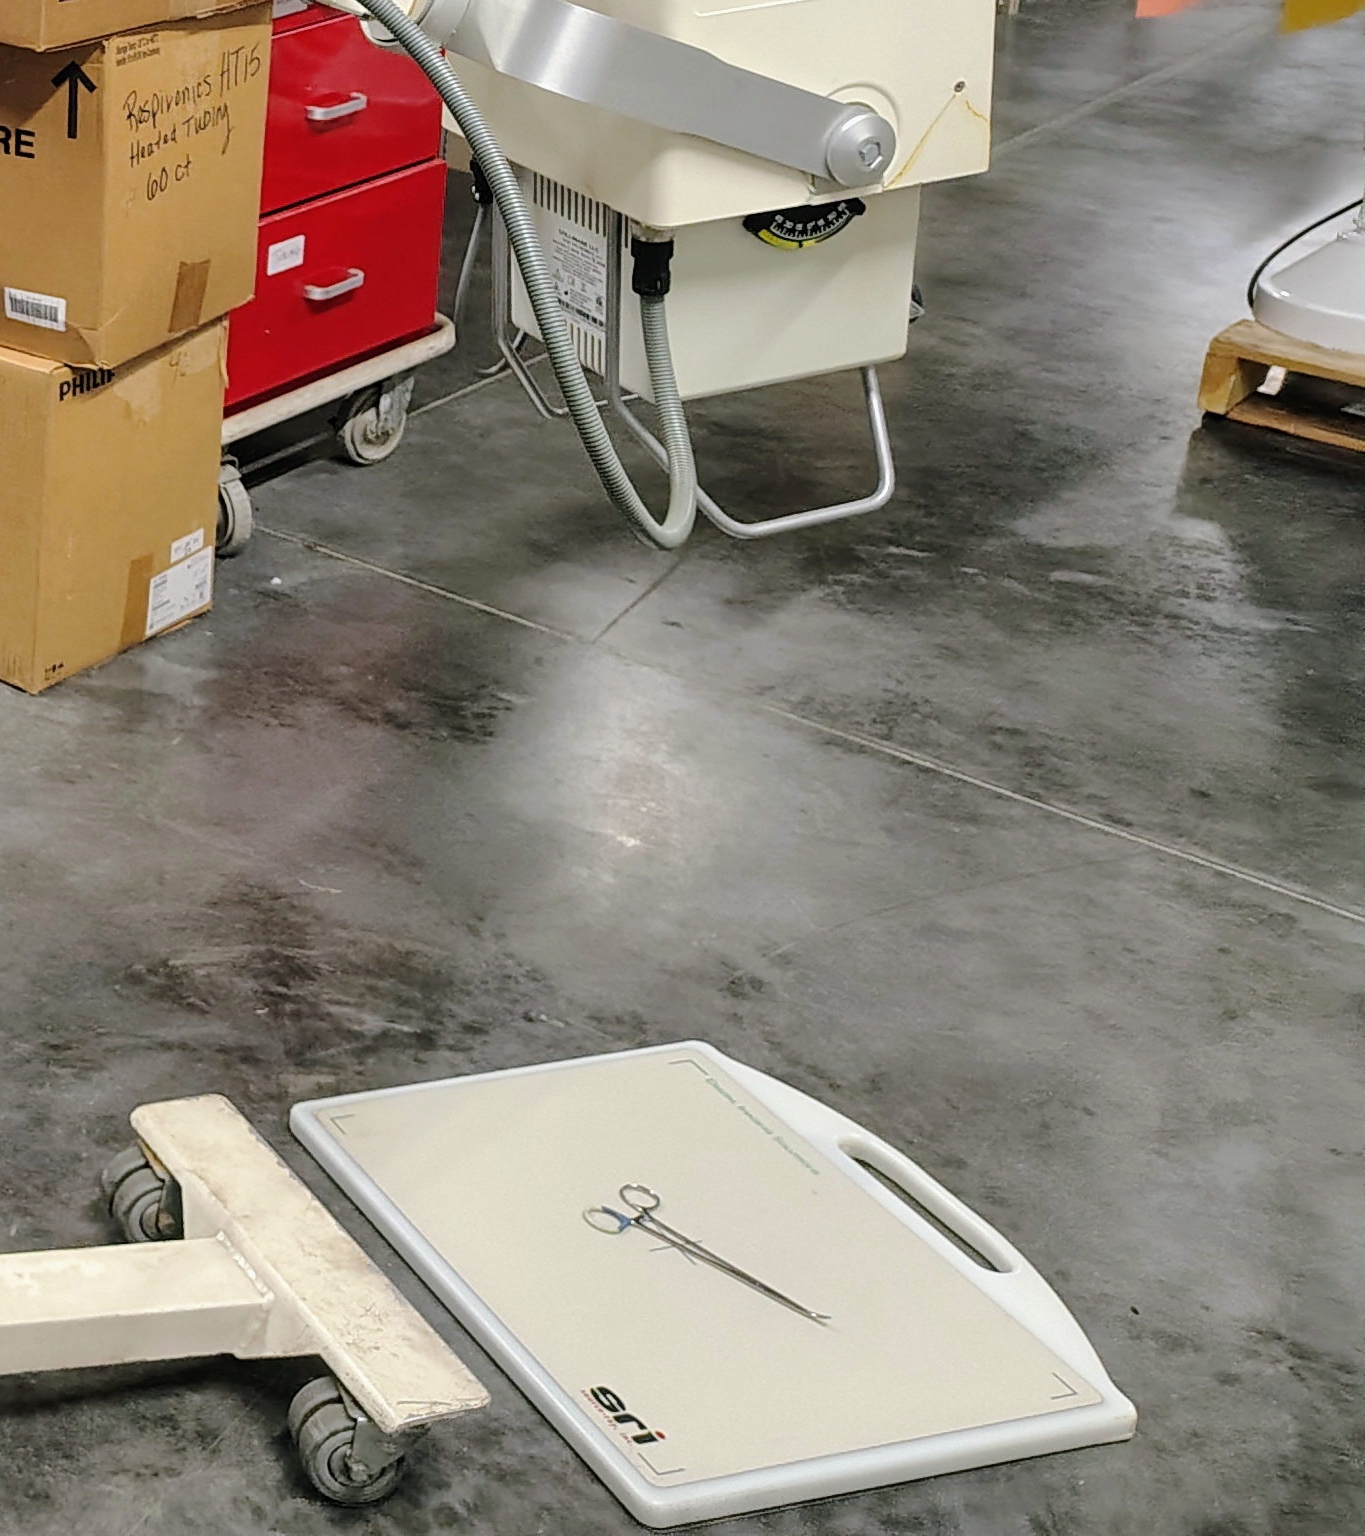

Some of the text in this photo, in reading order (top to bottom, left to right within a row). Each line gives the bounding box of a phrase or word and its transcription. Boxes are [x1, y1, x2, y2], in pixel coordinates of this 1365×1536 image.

[123, 74, 212, 132] Respironics
[219, 42, 261, 98] HT15
[130, 124, 177, 168] Heated
[146, 167, 168, 201] 60
[590, 1386, 666, 1444] sri
